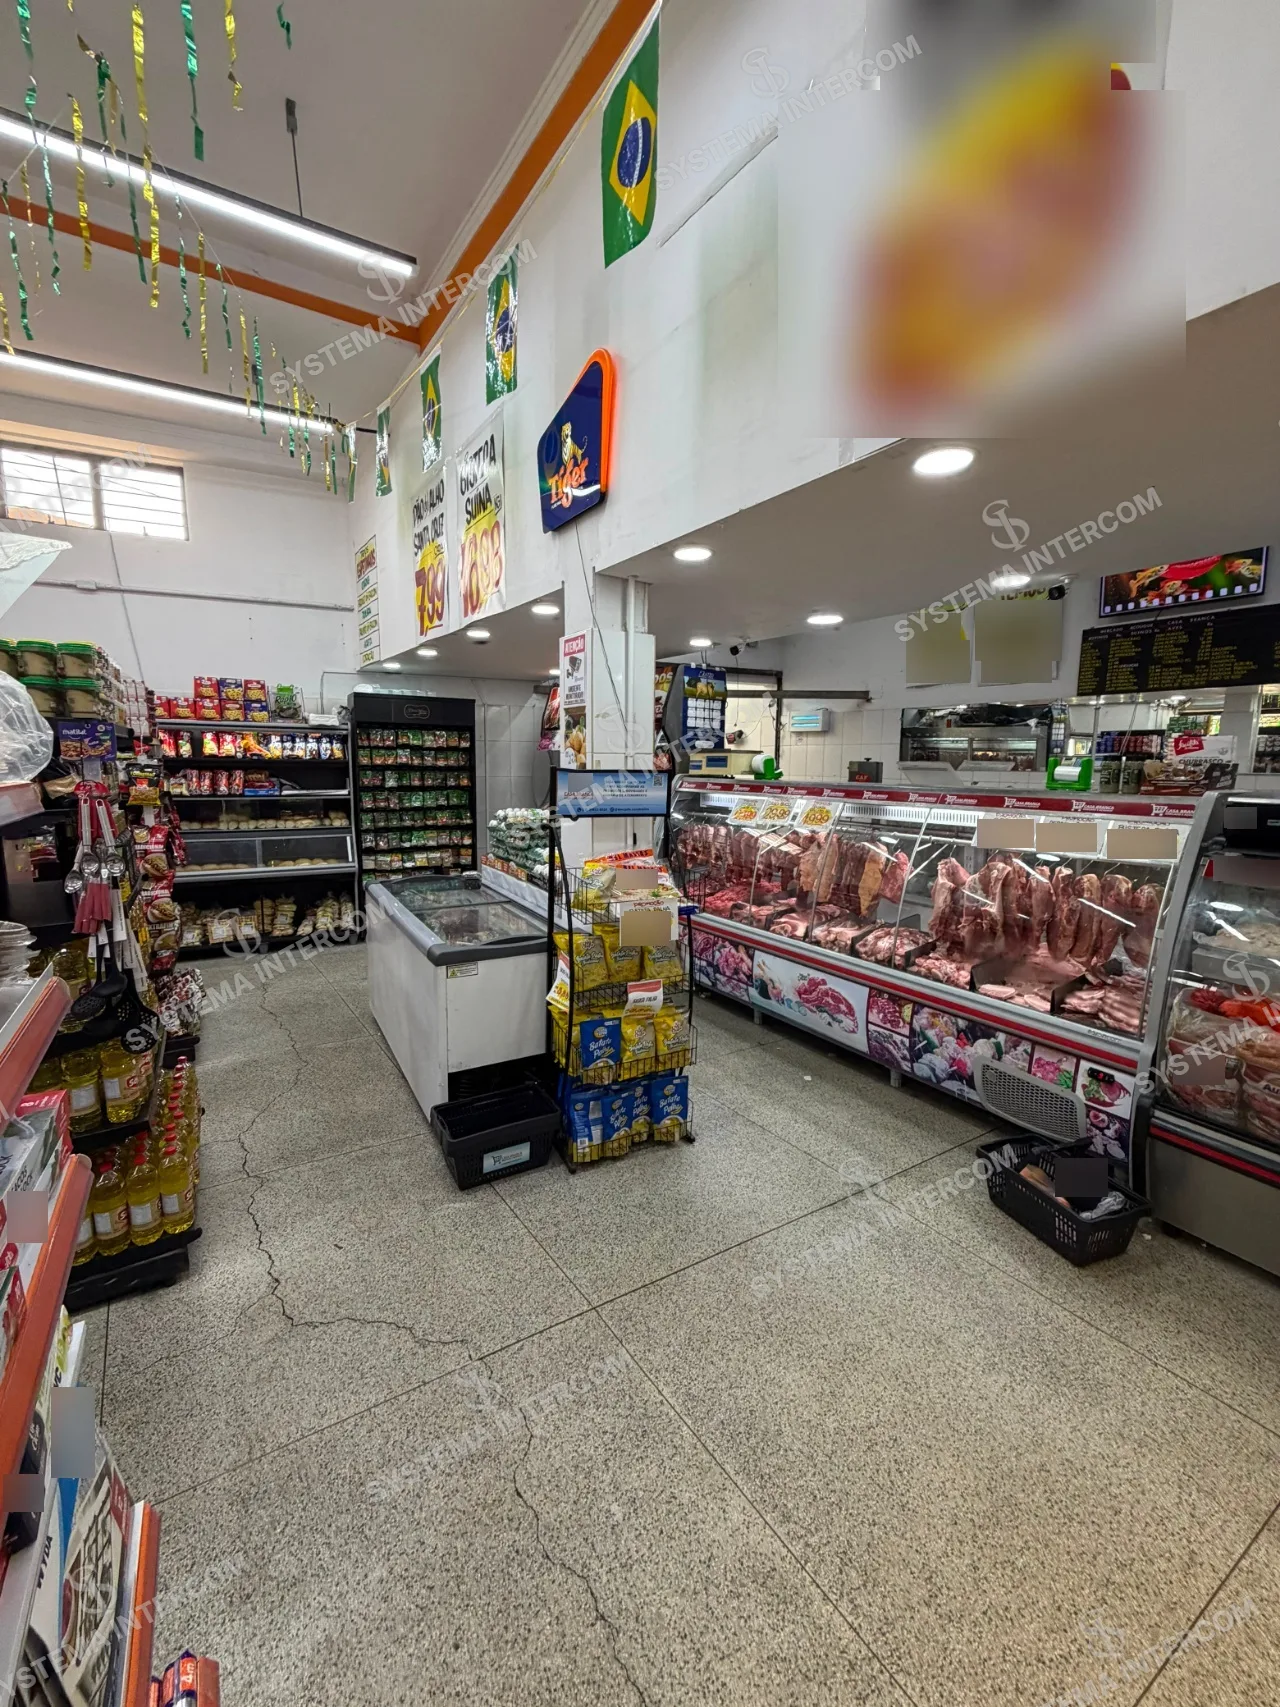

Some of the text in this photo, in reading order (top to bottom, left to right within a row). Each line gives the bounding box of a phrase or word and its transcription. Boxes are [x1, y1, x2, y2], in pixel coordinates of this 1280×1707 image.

[548, 457, 589, 508] Tiger
[36, 1536, 53, 1589] WYDA
[182, 1663, 195, 1684] 4m
